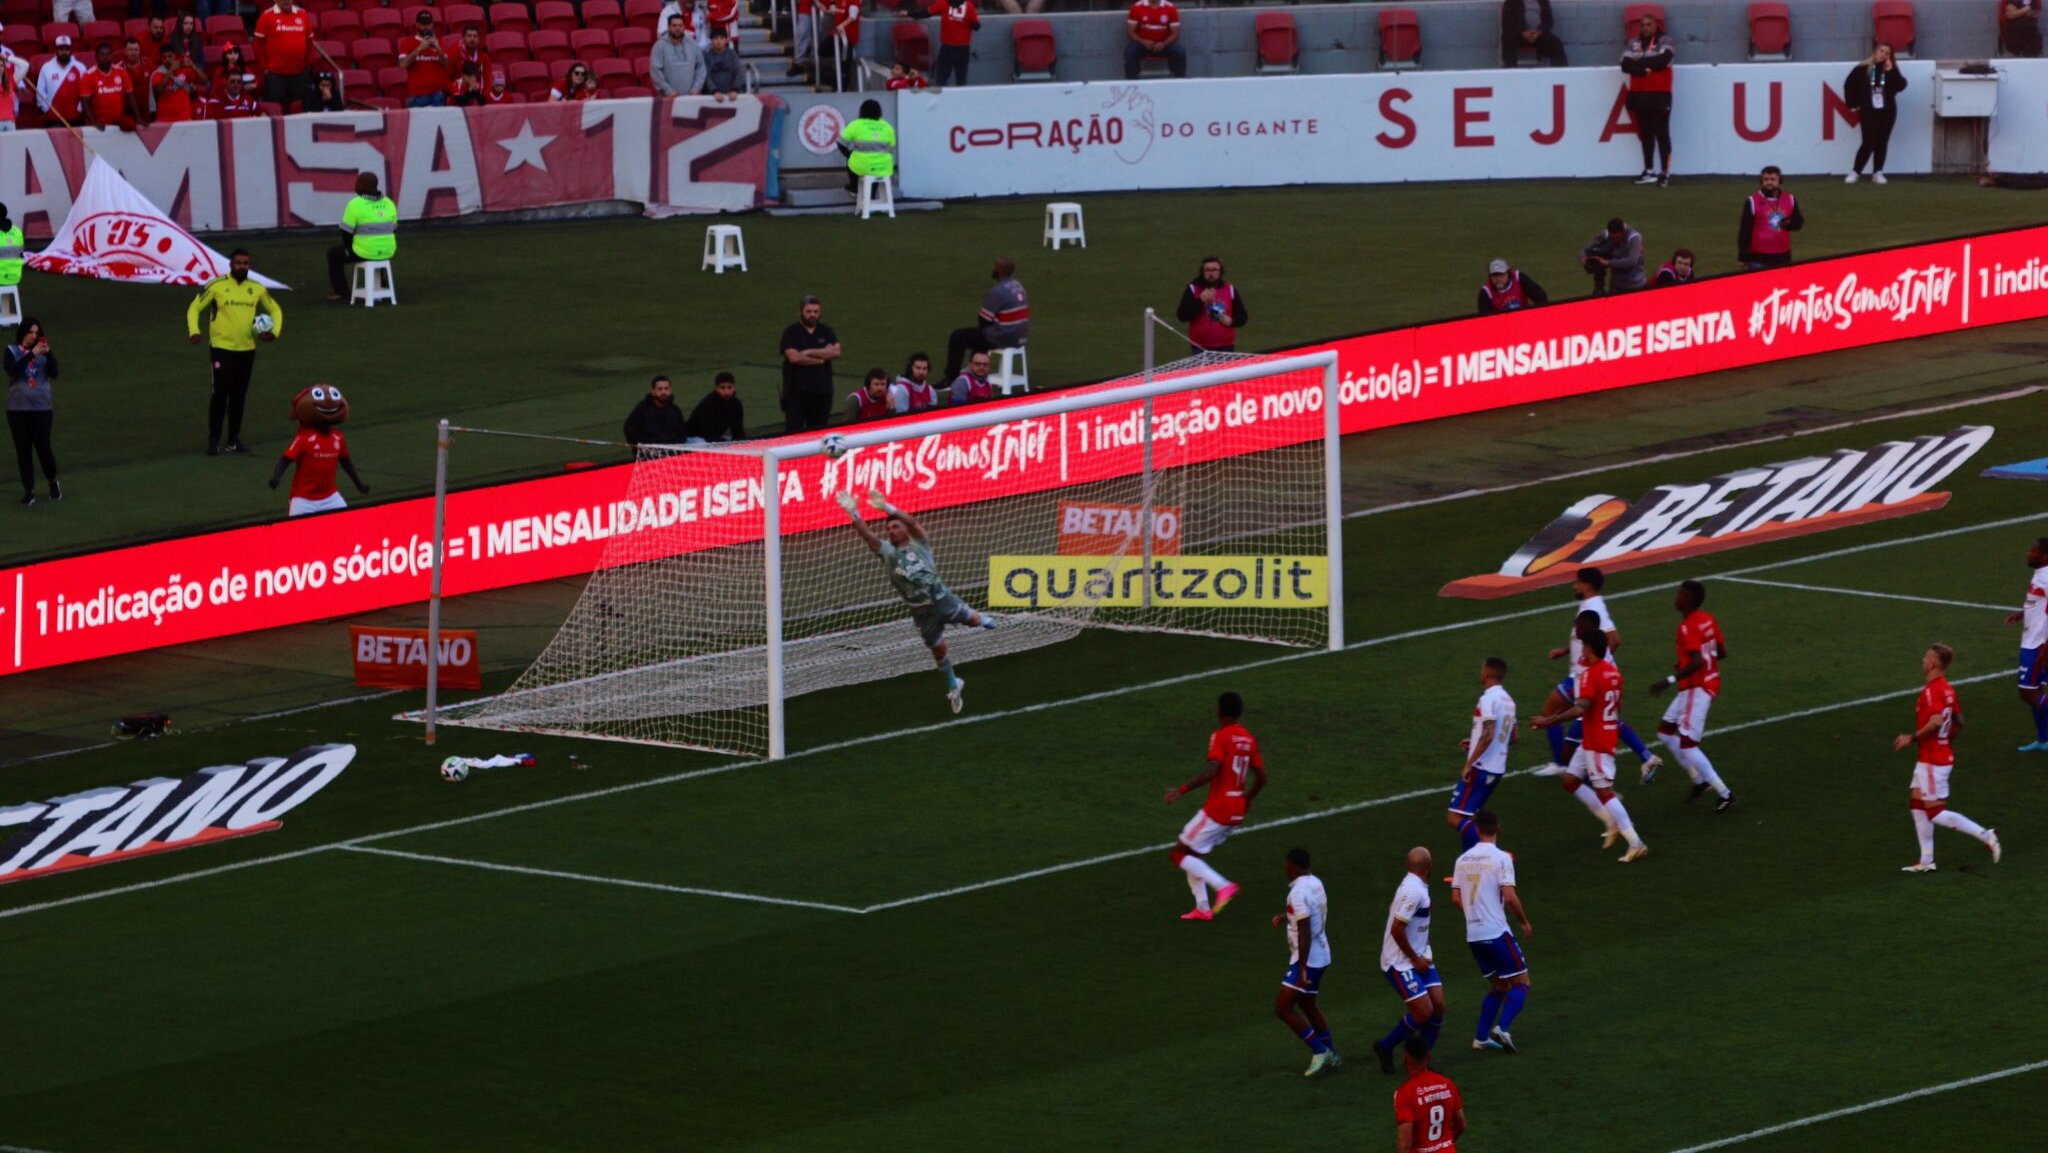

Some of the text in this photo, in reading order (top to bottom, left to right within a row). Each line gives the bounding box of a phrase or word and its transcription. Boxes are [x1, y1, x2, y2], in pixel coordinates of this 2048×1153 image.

[1161, 123, 1194, 138] DO
[1208, 119, 1318, 137] GIGANTE
[1375, 81, 1642, 149] SEJA
[581, 94, 763, 211] 12
[1979, 268, 1989, 298] 1
[1078, 420, 1088, 453] 1
[1225, 393, 1257, 427] de
[1263, 386, 1322, 420] novo
[1337, 360, 1421, 405] ócio(a)
[1457, 326, 1642, 386] MENSALIDADE
[1646, 310, 1735, 355] ISENTA
[1582, 424, 1995, 564] BETANO
[36, 600, 48, 636] 1
[56, 573, 204, 626] indicação
[209, 566, 248, 605] de
[255, 560, 327, 597] novo
[332, 534, 444, 584] sócio(a
[487, 487, 698, 557] MENSALIDADE
[1004, 558, 1312, 608] quartzolit
[1467, 874, 1481, 906] 7
[1429, 1105, 1444, 1141] 8
